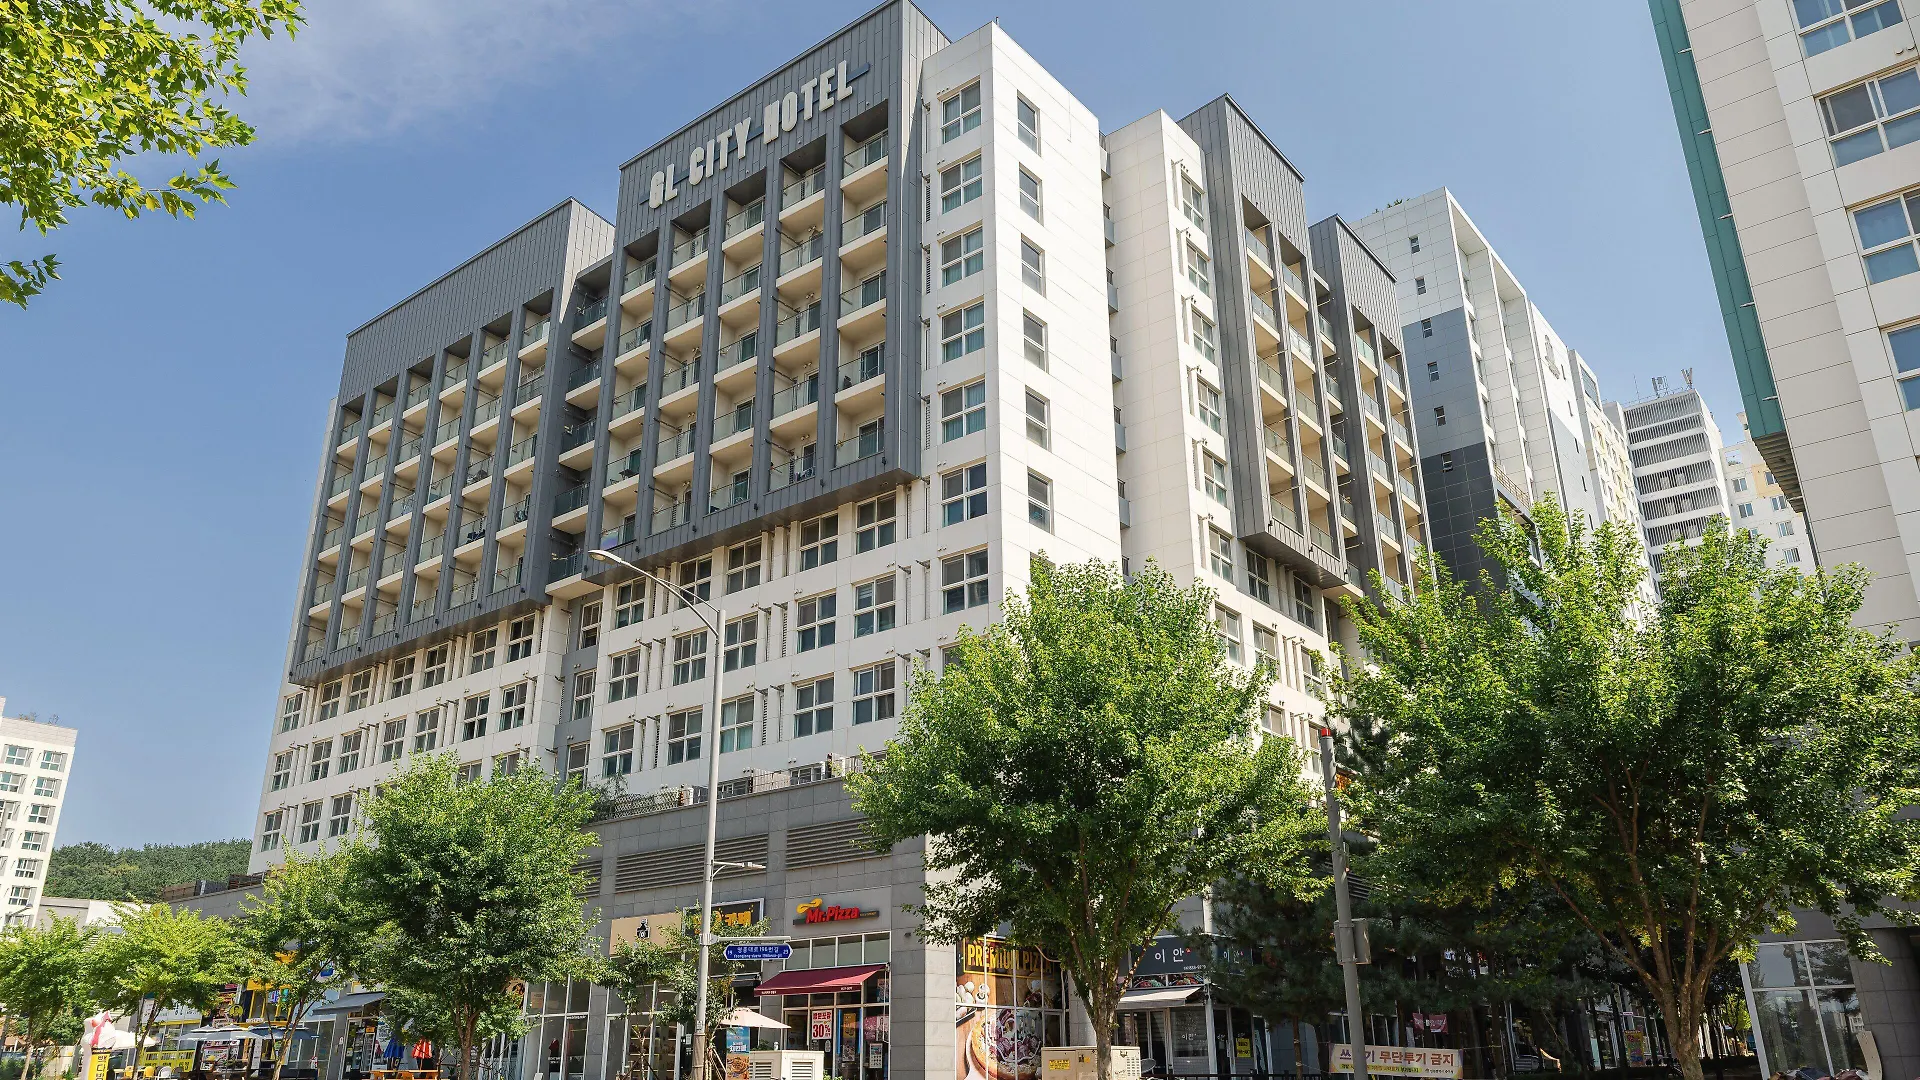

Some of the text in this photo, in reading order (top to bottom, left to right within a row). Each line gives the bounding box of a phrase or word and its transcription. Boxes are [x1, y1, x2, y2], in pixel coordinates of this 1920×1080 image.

[689, 116, 751, 186] CITY
[763, 60, 853, 144] HOTEL
[806, 905, 860, 924] Mr.Pizza
[967, 943, 1052, 974] PREMIUM PIZA
[1340, 1048, 1454, 1066] 쓰기 무단투기 금지
